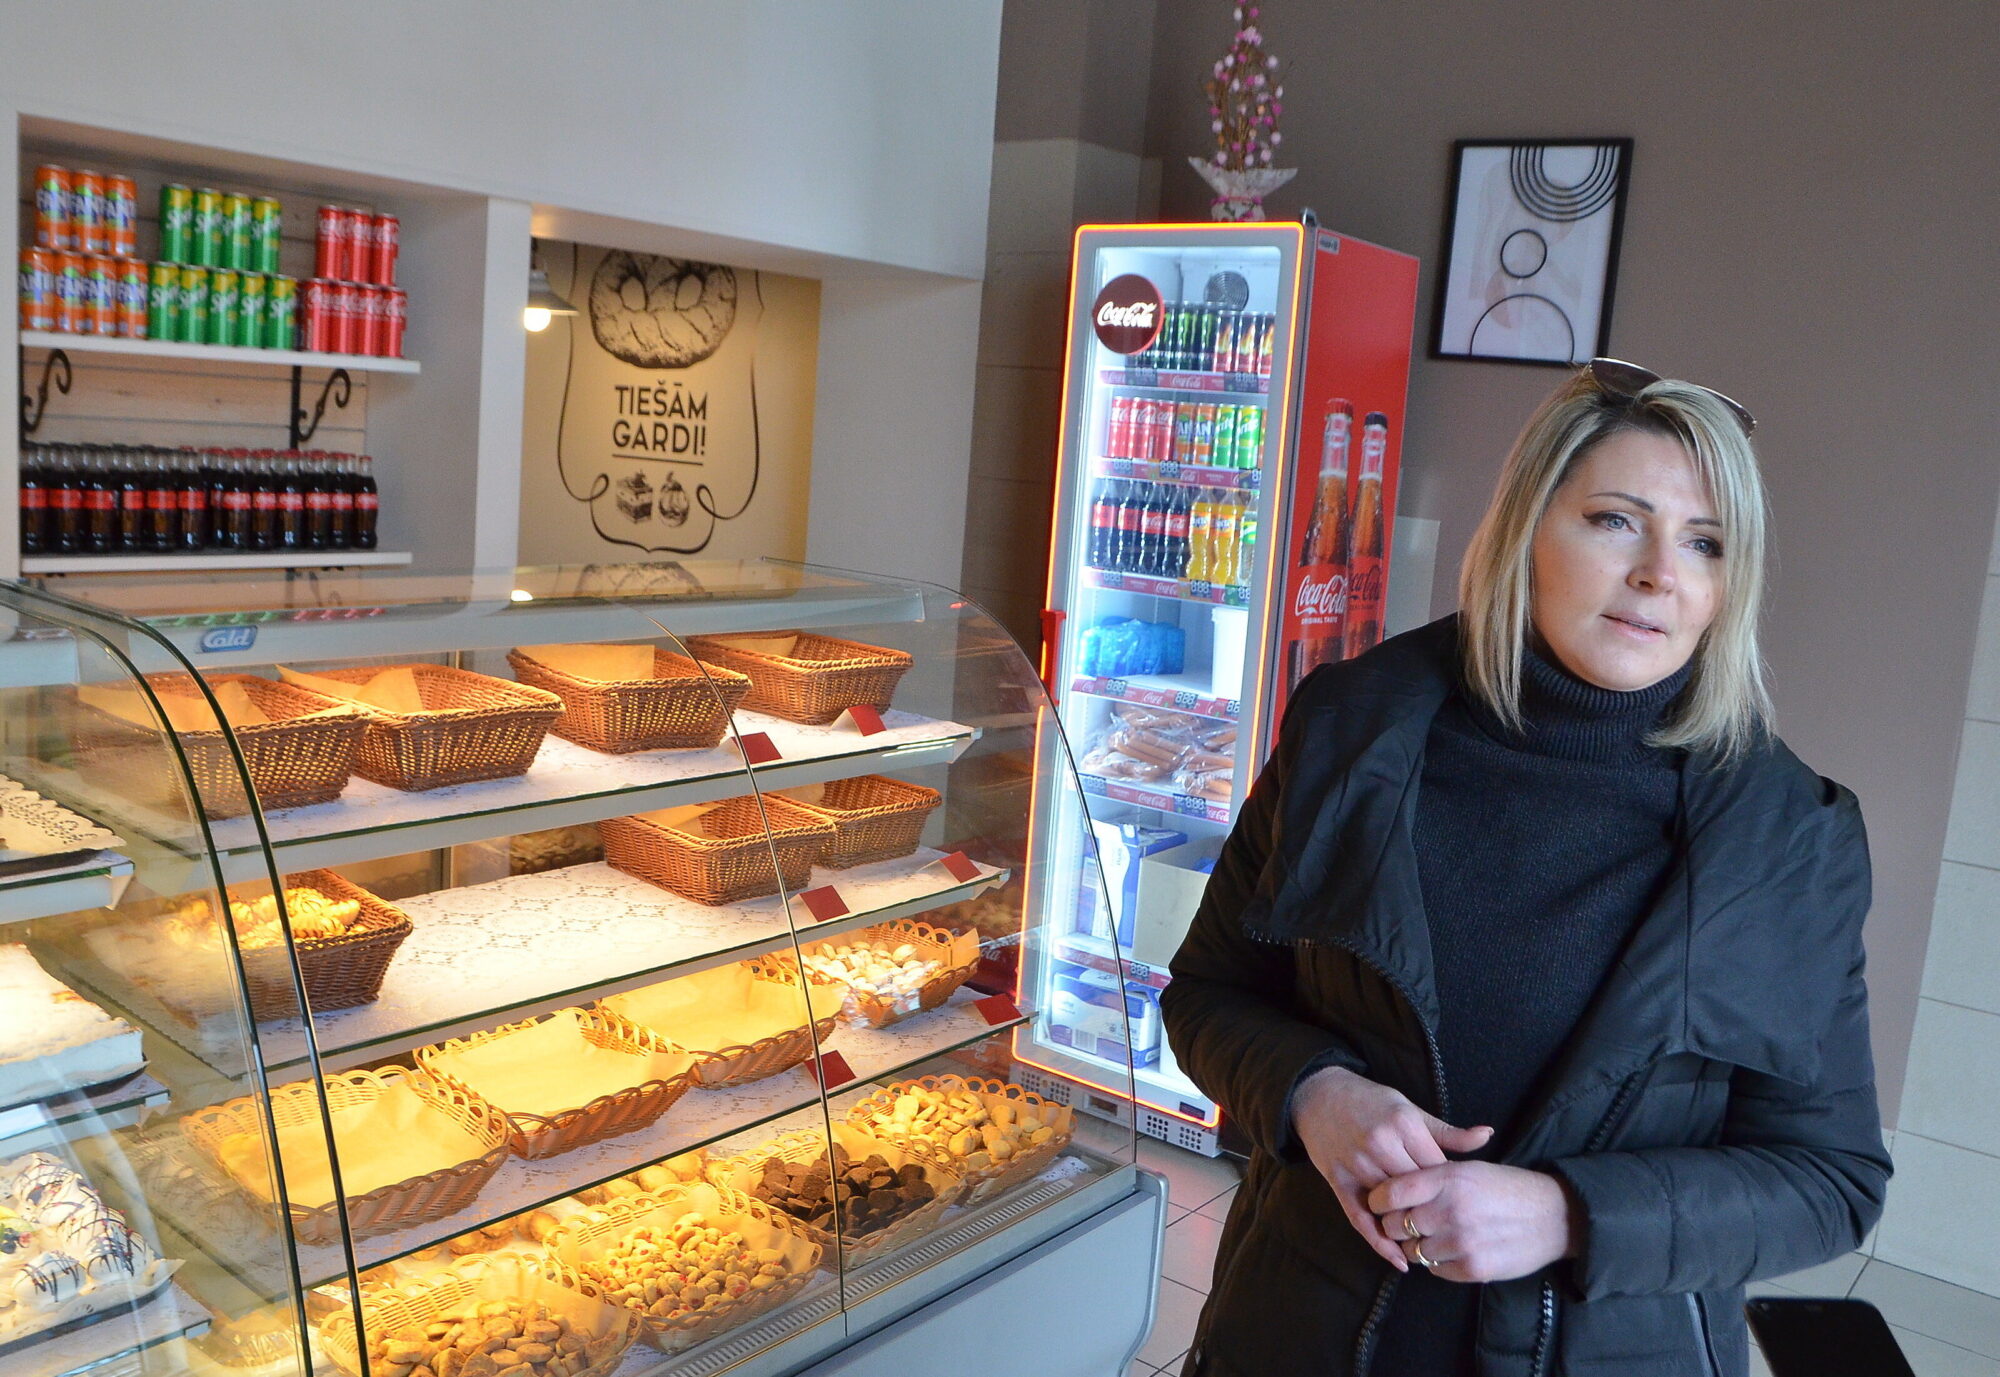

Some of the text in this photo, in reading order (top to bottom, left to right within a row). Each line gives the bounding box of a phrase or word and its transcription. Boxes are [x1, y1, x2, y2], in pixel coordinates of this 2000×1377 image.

[615, 379, 707, 420] TIEŠĀM
[613, 421, 706, 455] GARDI!
[203, 628, 251, 648] Cold
